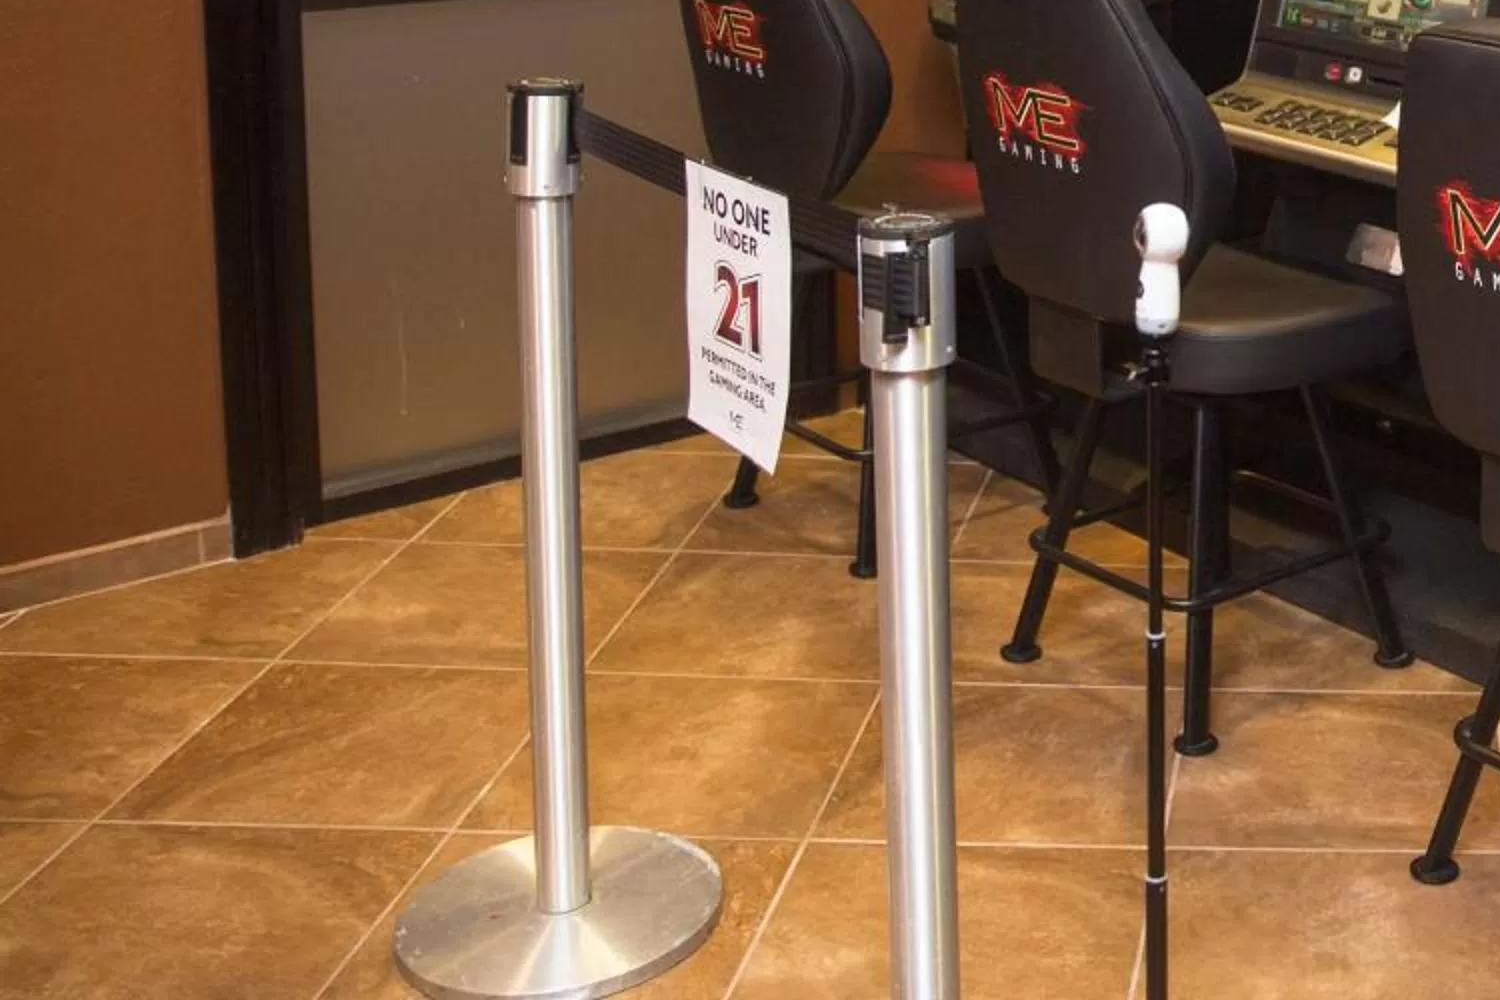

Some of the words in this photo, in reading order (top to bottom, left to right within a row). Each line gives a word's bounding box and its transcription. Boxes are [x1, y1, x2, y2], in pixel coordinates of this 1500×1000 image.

[987, 76, 1079, 151] ME
[999, 136, 1080, 174] GAMING
[702, 184, 728, 219] NO
[731, 198, 771, 236] ONE
[713, 220, 758, 257] UNDER
[713, 259, 763, 362] 21
[701, 346, 747, 381] PERMITTED
[759, 375, 776, 397] THE
[709, 369, 742, 399] GAMING
